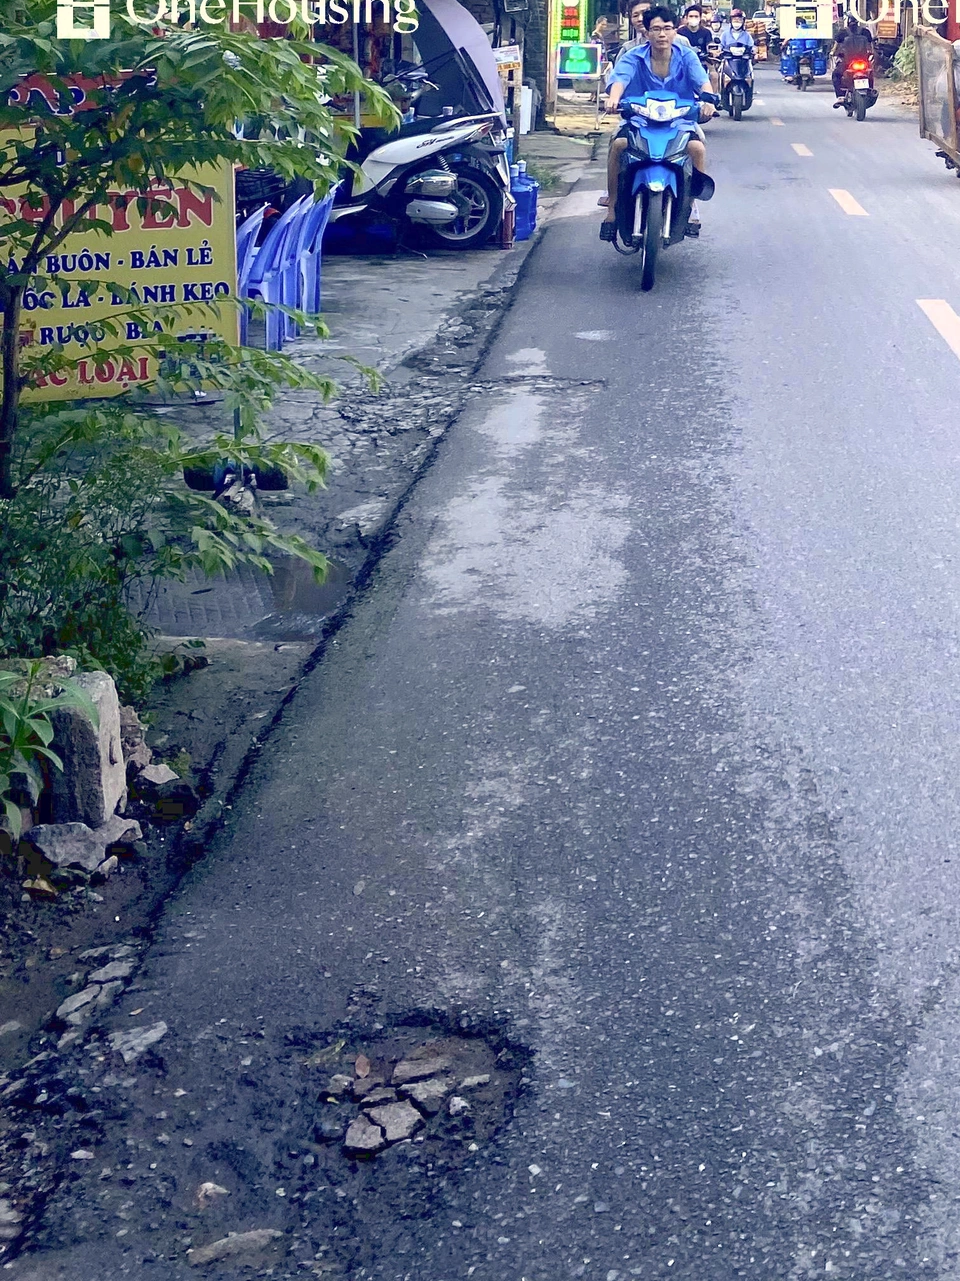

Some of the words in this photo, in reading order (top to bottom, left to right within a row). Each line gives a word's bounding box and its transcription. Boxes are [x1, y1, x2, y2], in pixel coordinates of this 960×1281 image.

[45, 248, 111, 274] BUÔN
[130, 244, 179, 270] BÁN
[185, 239, 214, 266] LẺ
[110, 281, 177, 307] BÁNH
[182, 281, 231, 307] KẸO
[76, 356, 150, 389] LOẠI
